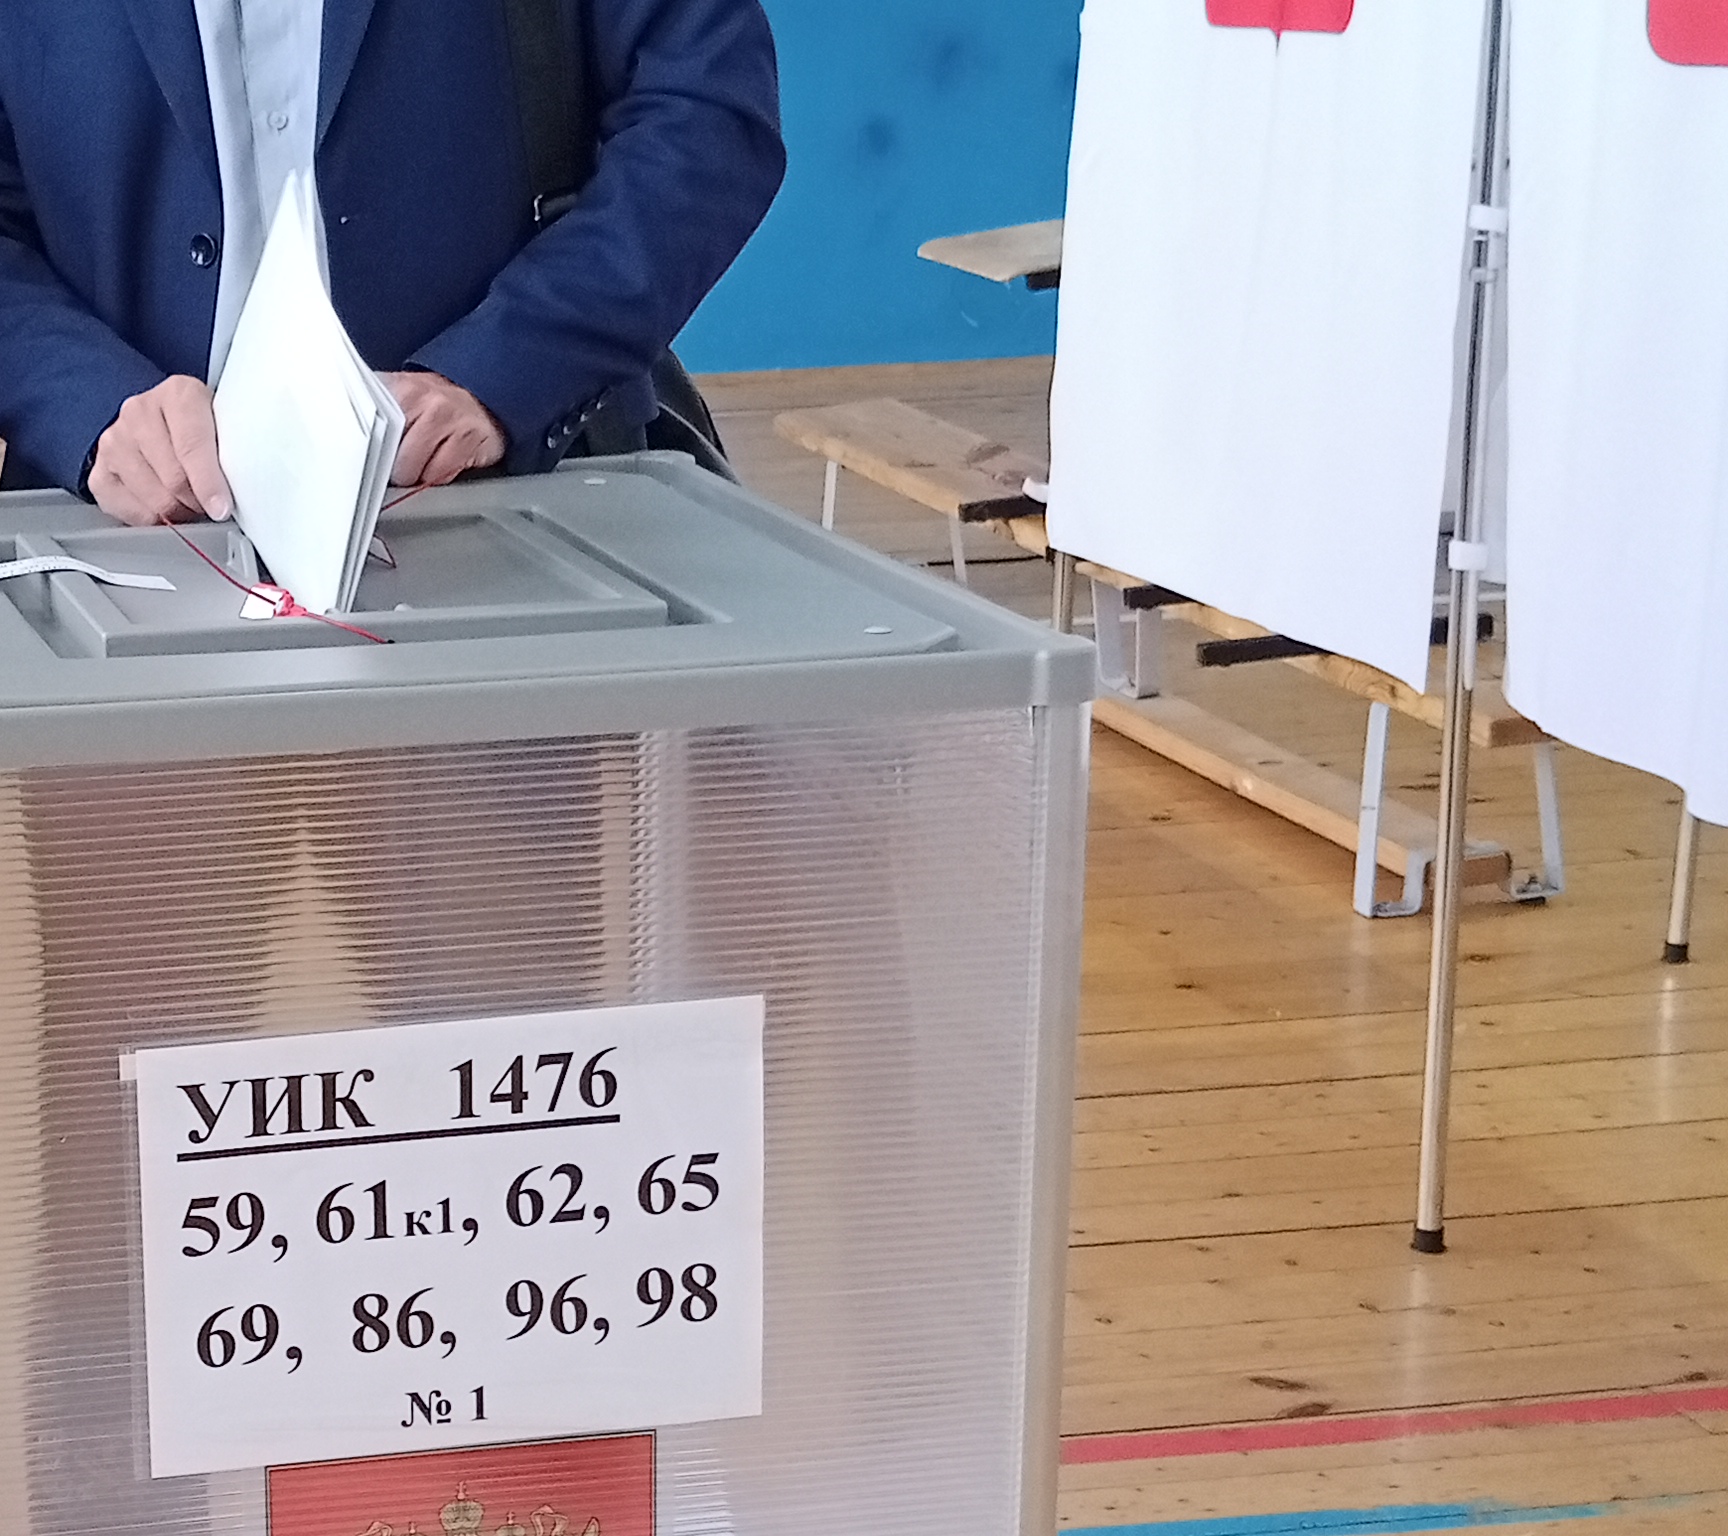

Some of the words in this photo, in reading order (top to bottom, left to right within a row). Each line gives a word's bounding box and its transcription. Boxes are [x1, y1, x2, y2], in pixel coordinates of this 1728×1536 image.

[176, 1068, 376, 1144] УИК
[449, 1046, 619, 1120] 1476
[181, 1192, 289, 1263] 59,
[316, 1179, 479, 1247] 61к1,
[506, 1163, 611, 1235] 62,
[637, 1152, 720, 1215] 65
[196, 1303, 303, 1375] 69,
[351, 1286, 457, 1359] 86,
[505, 1273, 610, 1346] 96,
[636, 1262, 719, 1329] 98
[401, 1390, 453, 1427] №
[469, 1385, 488, 1422] 1
